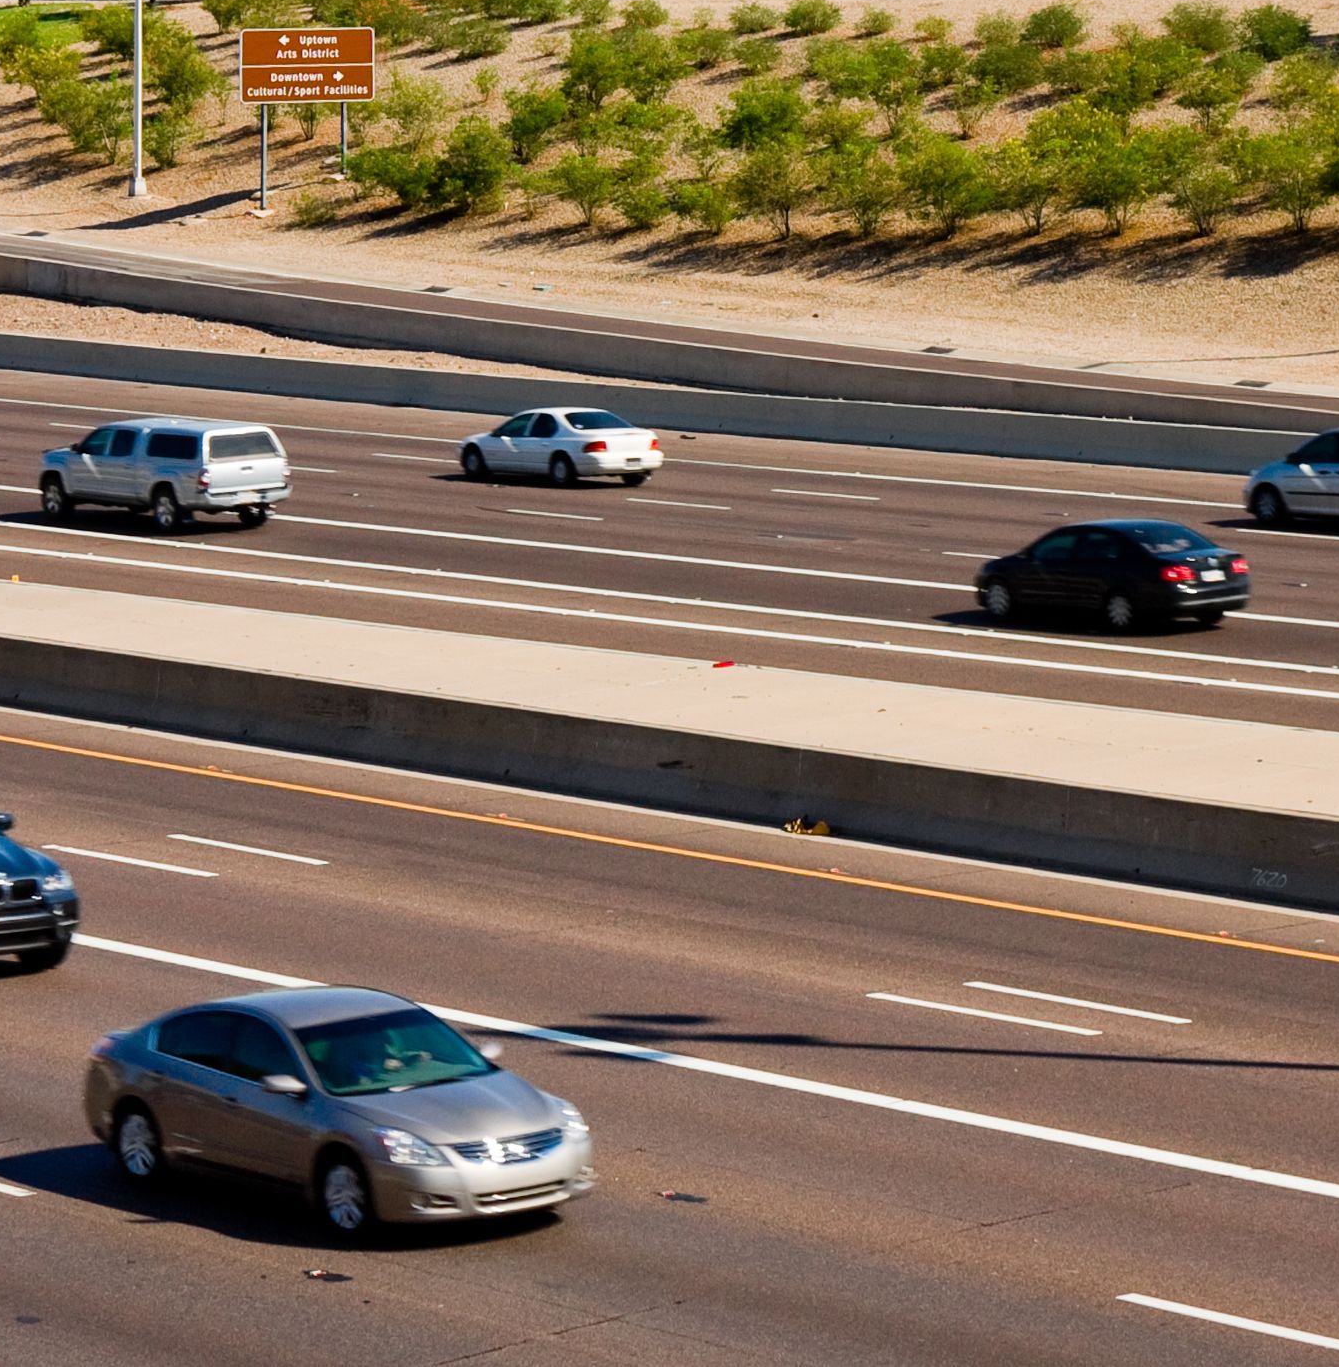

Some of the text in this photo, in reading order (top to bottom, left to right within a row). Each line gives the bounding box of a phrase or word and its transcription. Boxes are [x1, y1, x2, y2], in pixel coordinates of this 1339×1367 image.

[299, 35, 337, 46] Uptown
[276, 48, 339, 59] Arts District
[270, 73, 323, 82] Downtown
[324, 84, 368, 95] Facilities
